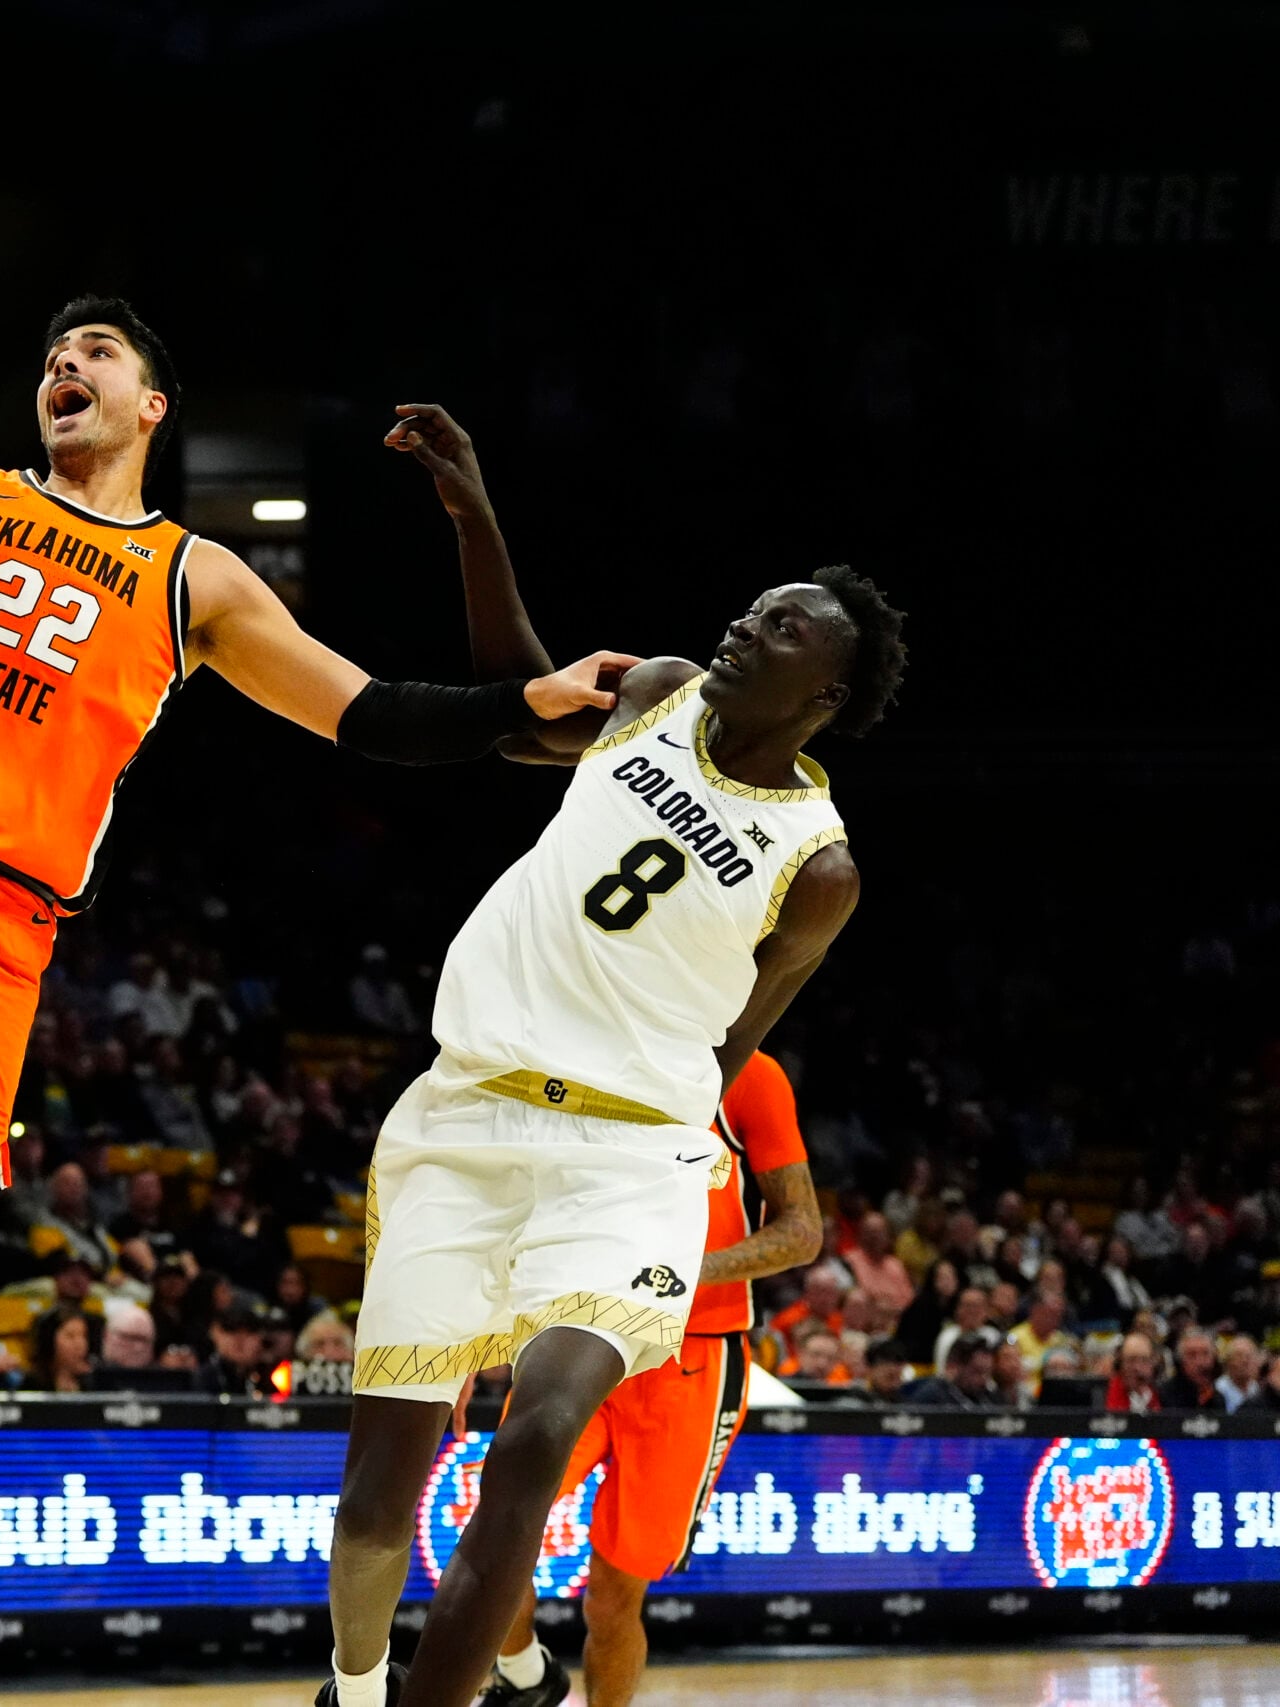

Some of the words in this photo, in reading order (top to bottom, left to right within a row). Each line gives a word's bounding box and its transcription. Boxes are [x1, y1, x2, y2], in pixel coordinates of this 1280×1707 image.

[1007, 168, 1240, 246] WHERE
[612, 757, 753, 887] COLORADO
[581, 834, 688, 935] 8
[1192, 1492, 1223, 1549] a
